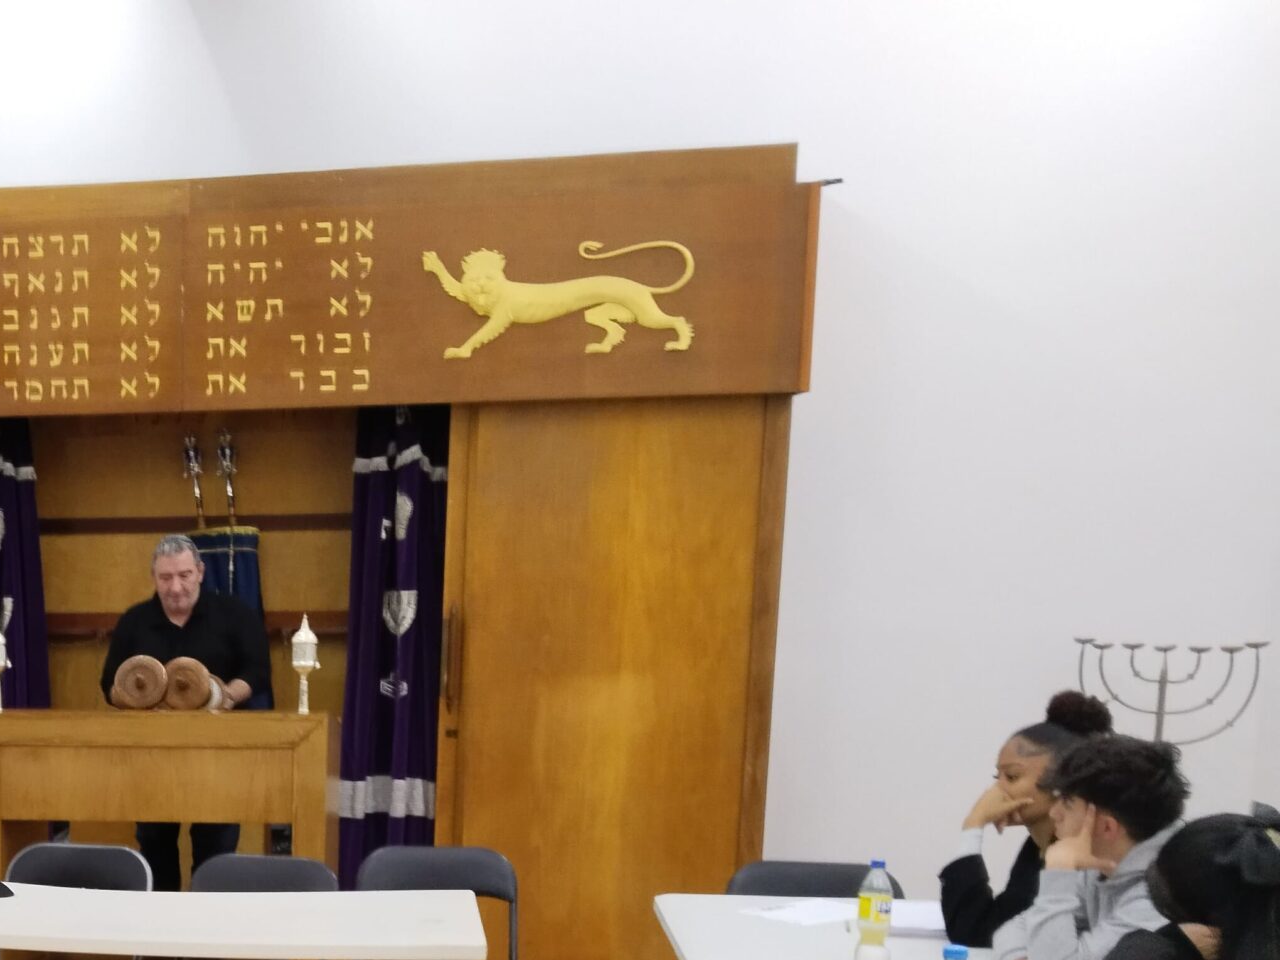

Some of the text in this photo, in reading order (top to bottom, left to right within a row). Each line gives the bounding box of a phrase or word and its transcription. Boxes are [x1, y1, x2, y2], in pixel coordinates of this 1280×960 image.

[2, 224, 161, 259] לא תרצח
[207, 222, 284, 248] יהוה
[2, 260, 161, 298] לא תנאף
[207, 250, 373, 285] לא יהיה
[120, 297, 161, 326] לא
[329, 288, 372, 317] לא
[2, 333, 161, 368] לא תענה
[206, 336, 248, 360] את
[3, 370, 161, 401] לא תחמד
[205, 372, 247, 397] את
